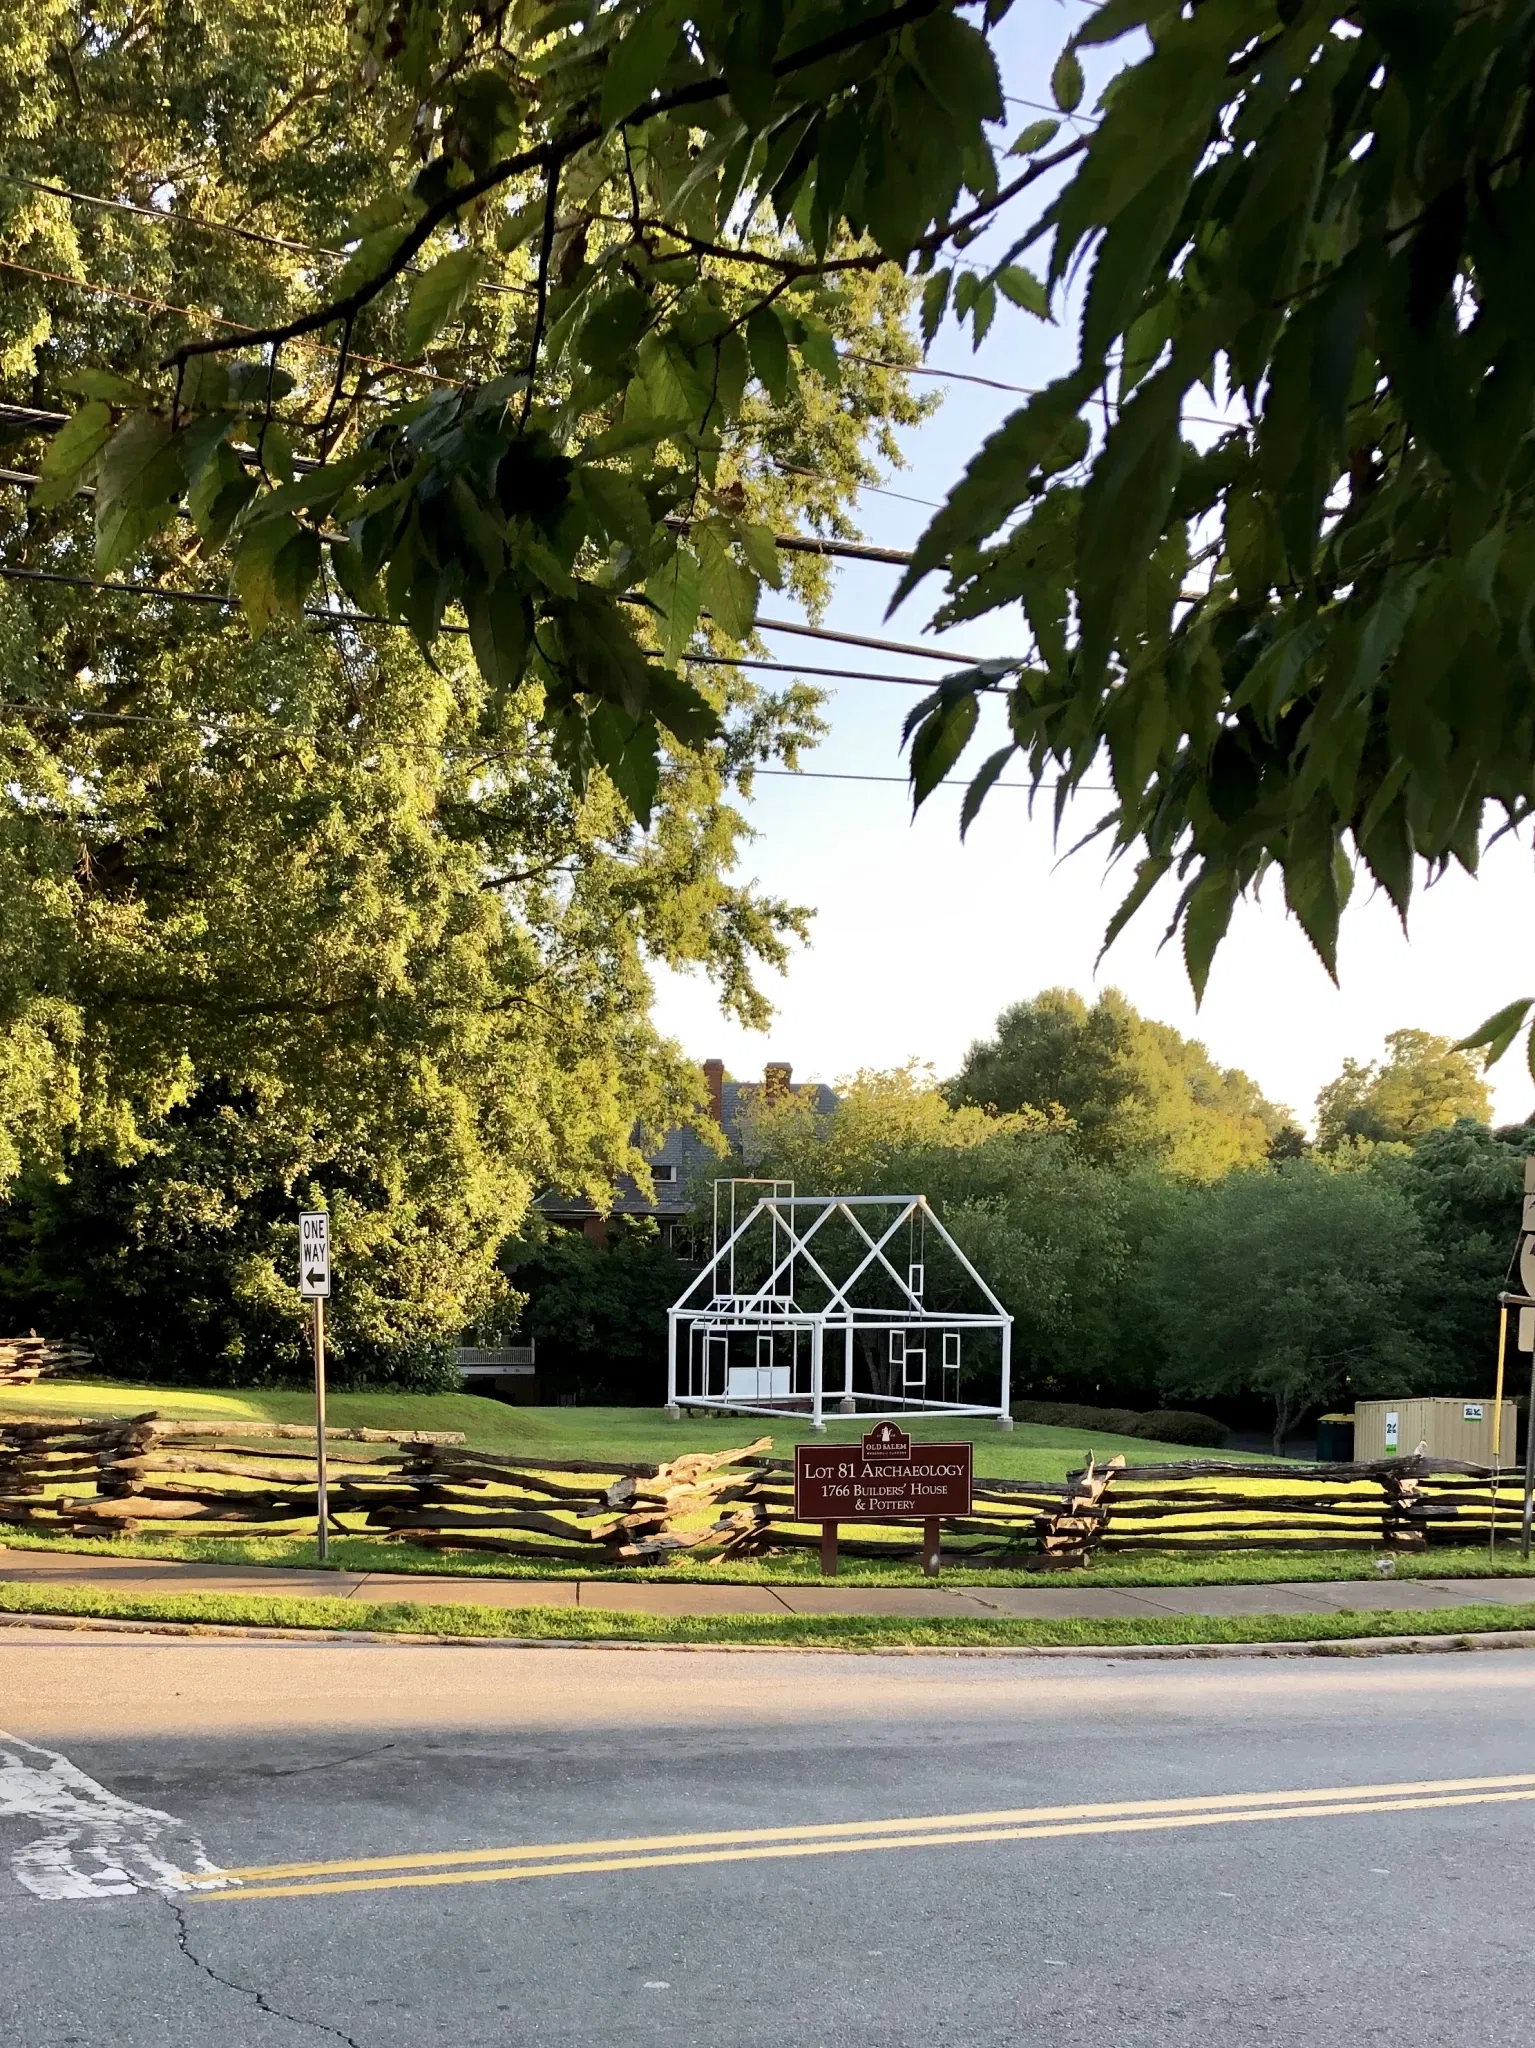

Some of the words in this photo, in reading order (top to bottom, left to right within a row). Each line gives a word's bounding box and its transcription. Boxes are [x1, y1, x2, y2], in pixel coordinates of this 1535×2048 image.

[303, 1220, 325, 1239] ONE
[303, 1243, 326, 1262] WAY
[865, 1443, 881, 1451] OLD
[804, 1463, 834, 1479] LOT
[838, 1463, 855, 1478] 81
[860, 1462, 965, 1478] ARCHAEOLOGY
[821, 1484, 850, 1498] 1766
[910, 1483, 948, 1496] HOUSE
[854, 1498, 866, 1511] &
[869, 1498, 916, 1511] POTTERY
